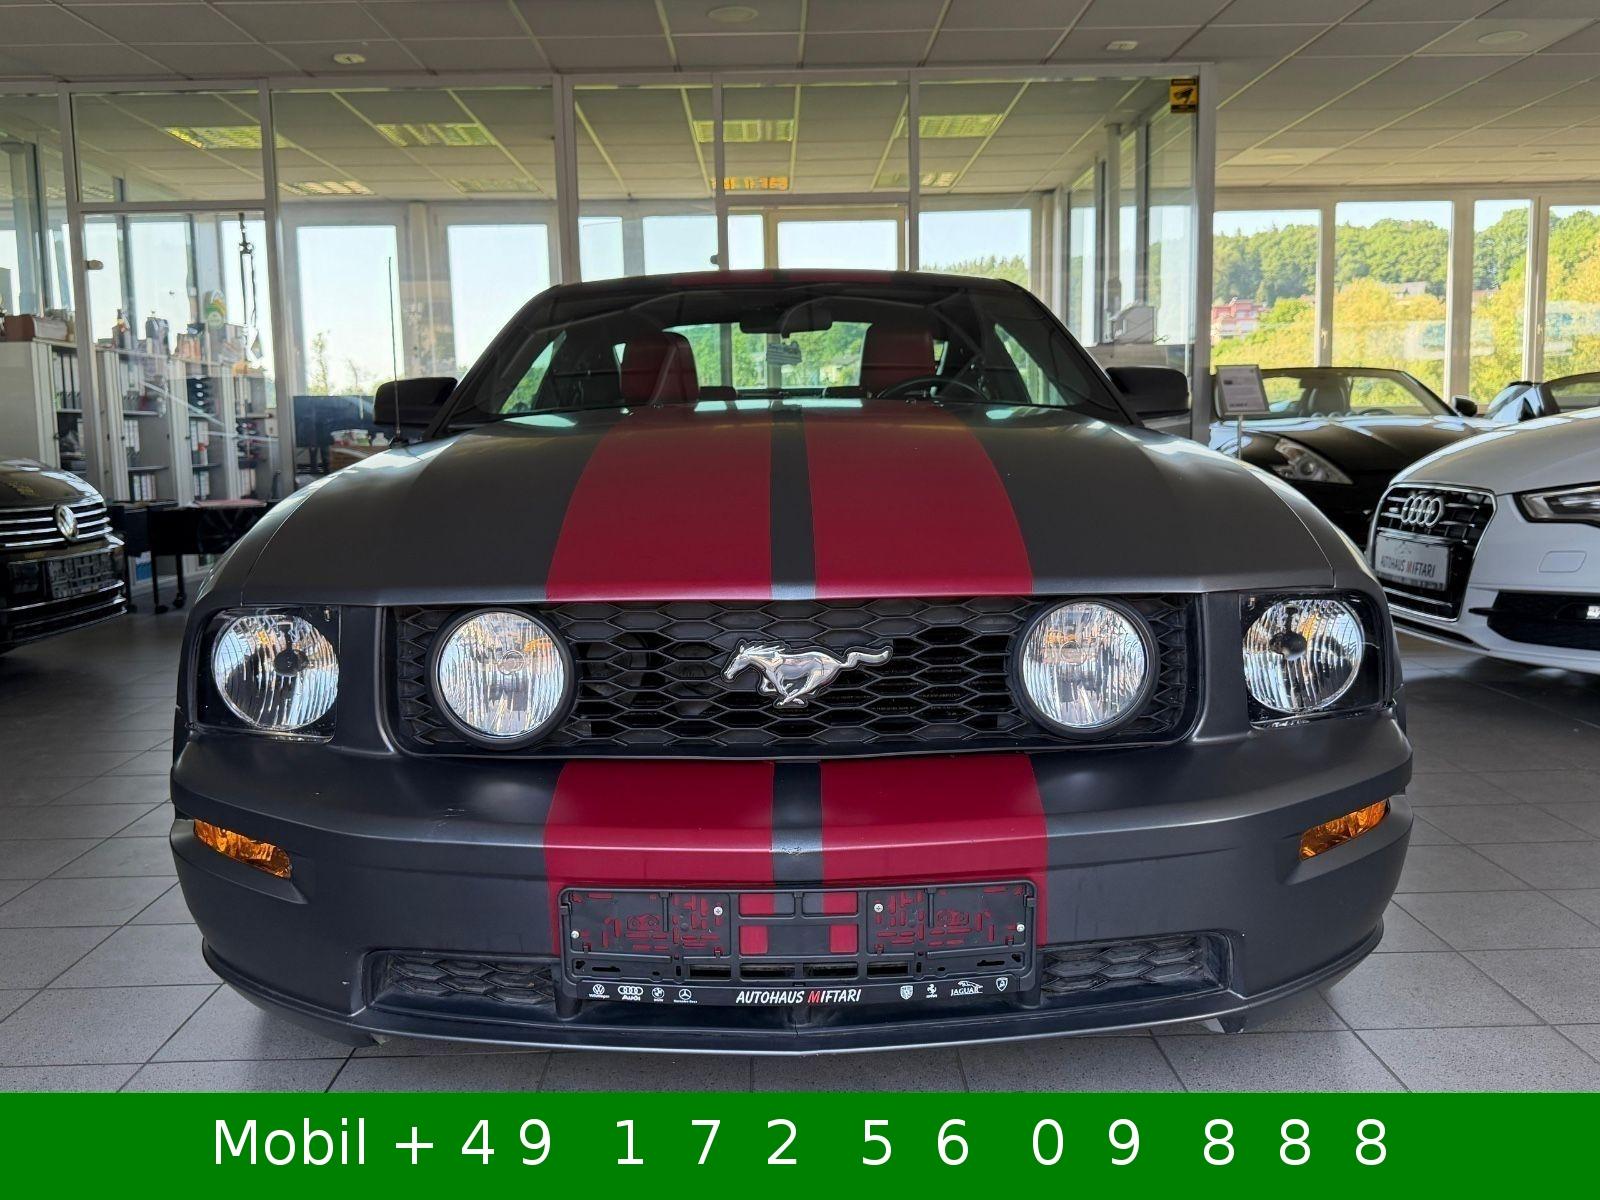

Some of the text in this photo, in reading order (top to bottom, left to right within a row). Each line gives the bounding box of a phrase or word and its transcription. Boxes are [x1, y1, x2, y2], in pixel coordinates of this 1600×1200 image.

[1407, 560, 1436, 577] MIFTARI
[735, 988, 862, 1004] AUTOHAUS MIFTARI
[950, 987, 981, 997] JAGUAR
